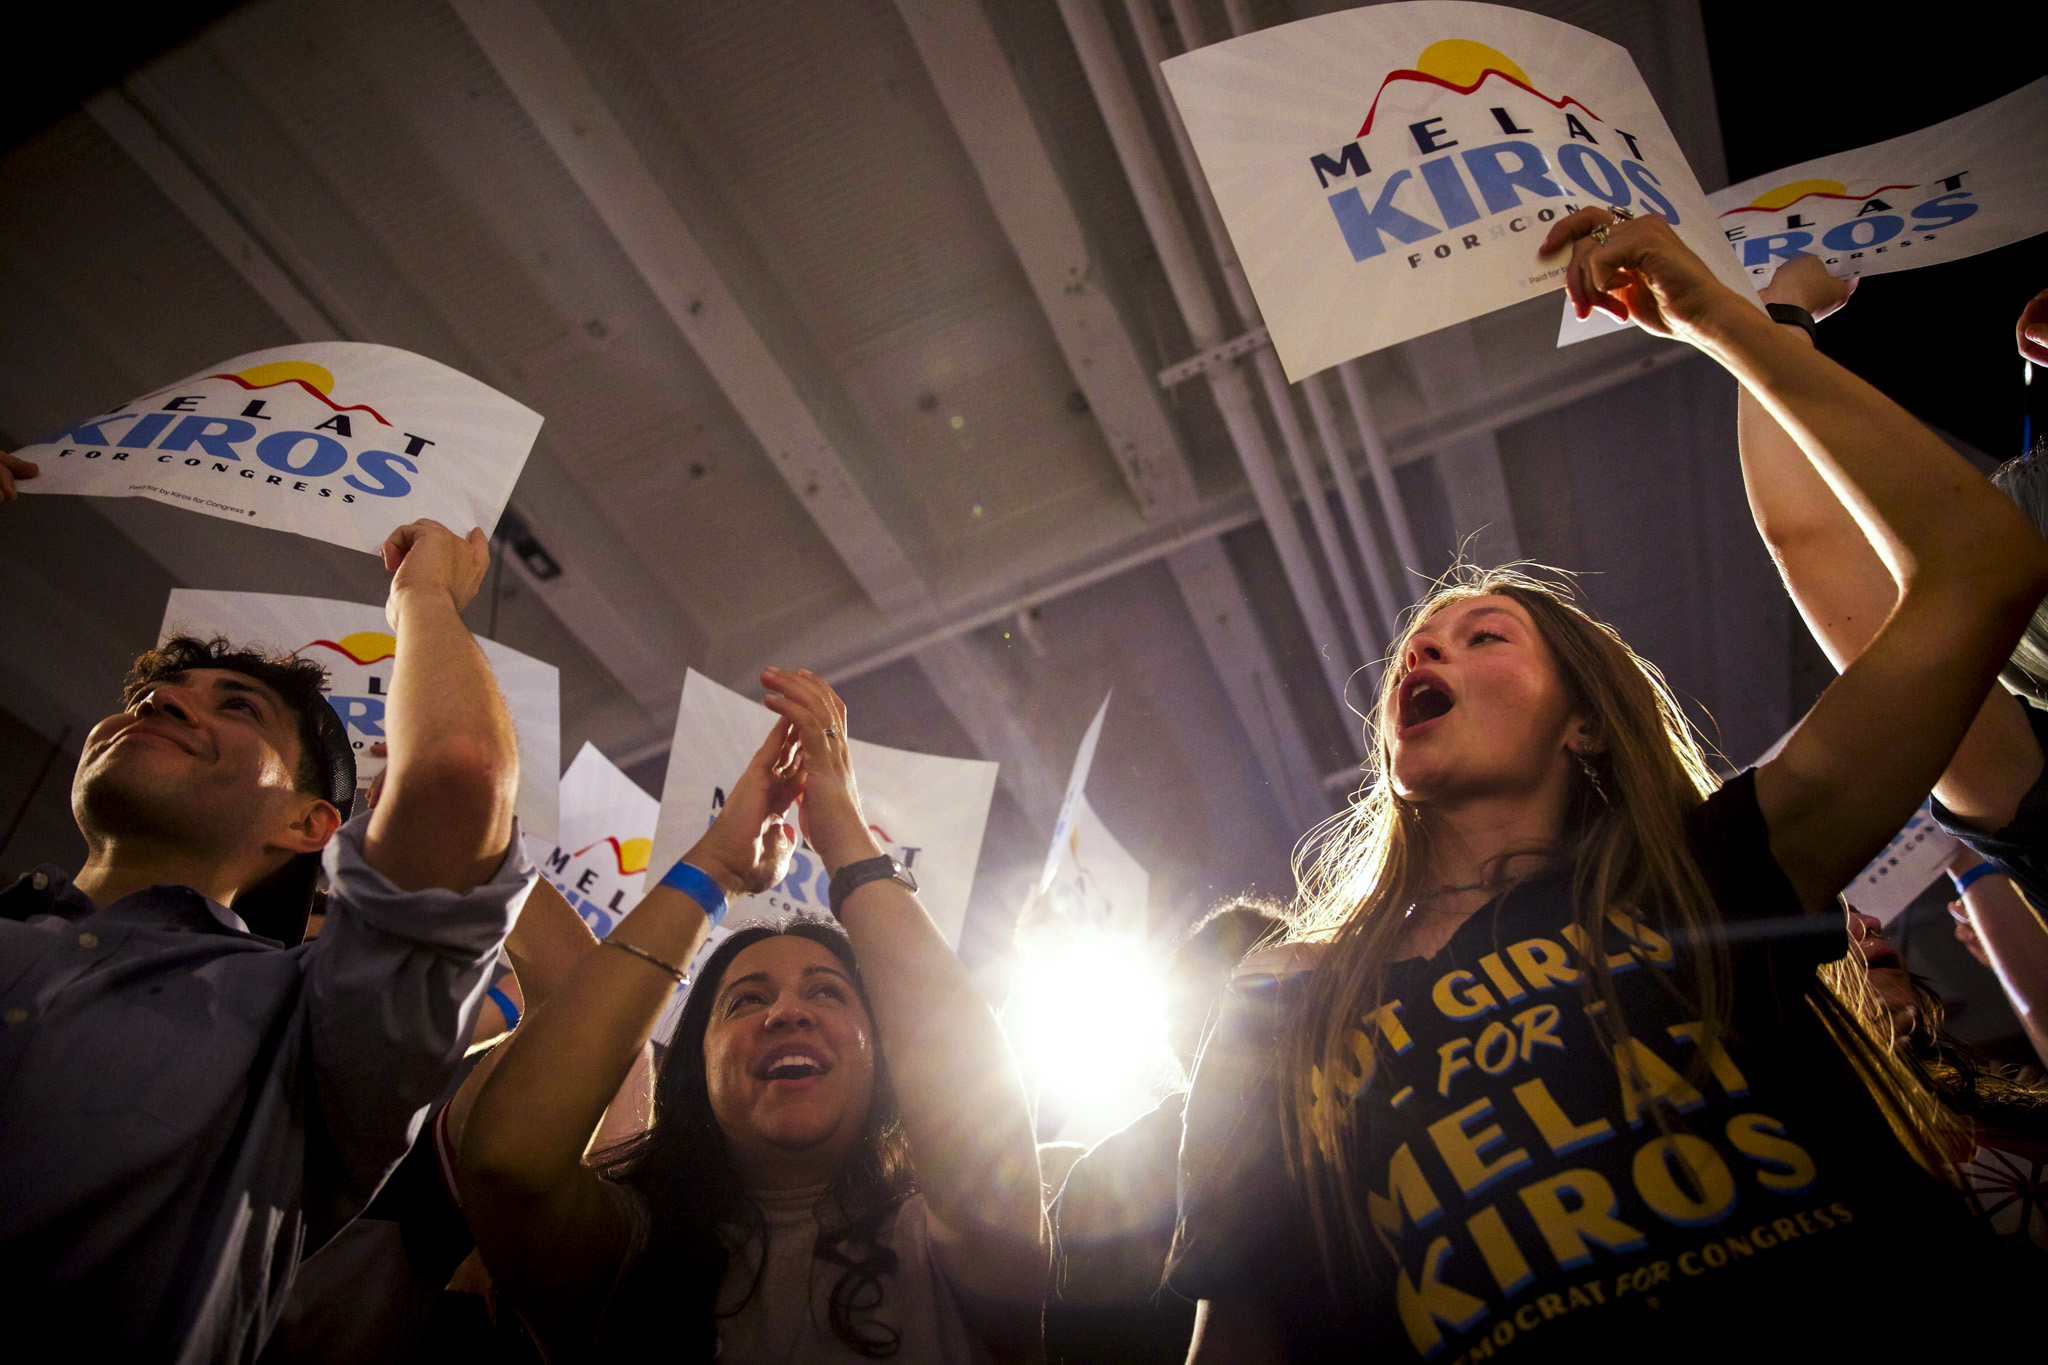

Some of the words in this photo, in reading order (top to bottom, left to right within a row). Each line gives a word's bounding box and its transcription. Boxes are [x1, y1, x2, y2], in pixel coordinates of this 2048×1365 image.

[1310, 107, 1645, 189] MELAT
[1327, 140, 1682, 263] KIROS
[1724, 170, 1969, 242] ELAT
[1731, 191, 1979, 268] ROS
[1407, 233, 1481, 270] FOR
[1529, 273, 1547, 284] Paid
[1752, 234, 1936, 275] CGRESS
[33, 412, 419, 498] KIROS
[105, 395, 436, 458] ELAT
[59, 449, 130, 461] FOR
[157, 455, 356, 504] CONGRESS
[160, 488, 171, 497] by
[171, 490, 192, 502] Kiros
[193, 496, 206, 504] for
[206, 500, 244, 515] Congress
[544, 846, 626, 915] MEL
[1432, 908, 1677, 1022] GIRLS
[1437, 1003, 1565, 1098] FOR
[1368, 1020, 1750, 1250] MELAT
[1398, 1112, 1818, 1362] KIROS
[1452, 1279, 1607, 1365] MOCRAT
[1615, 1259, 1672, 1300] FOR
[1676, 1201, 1856, 1279] CONGRESS
